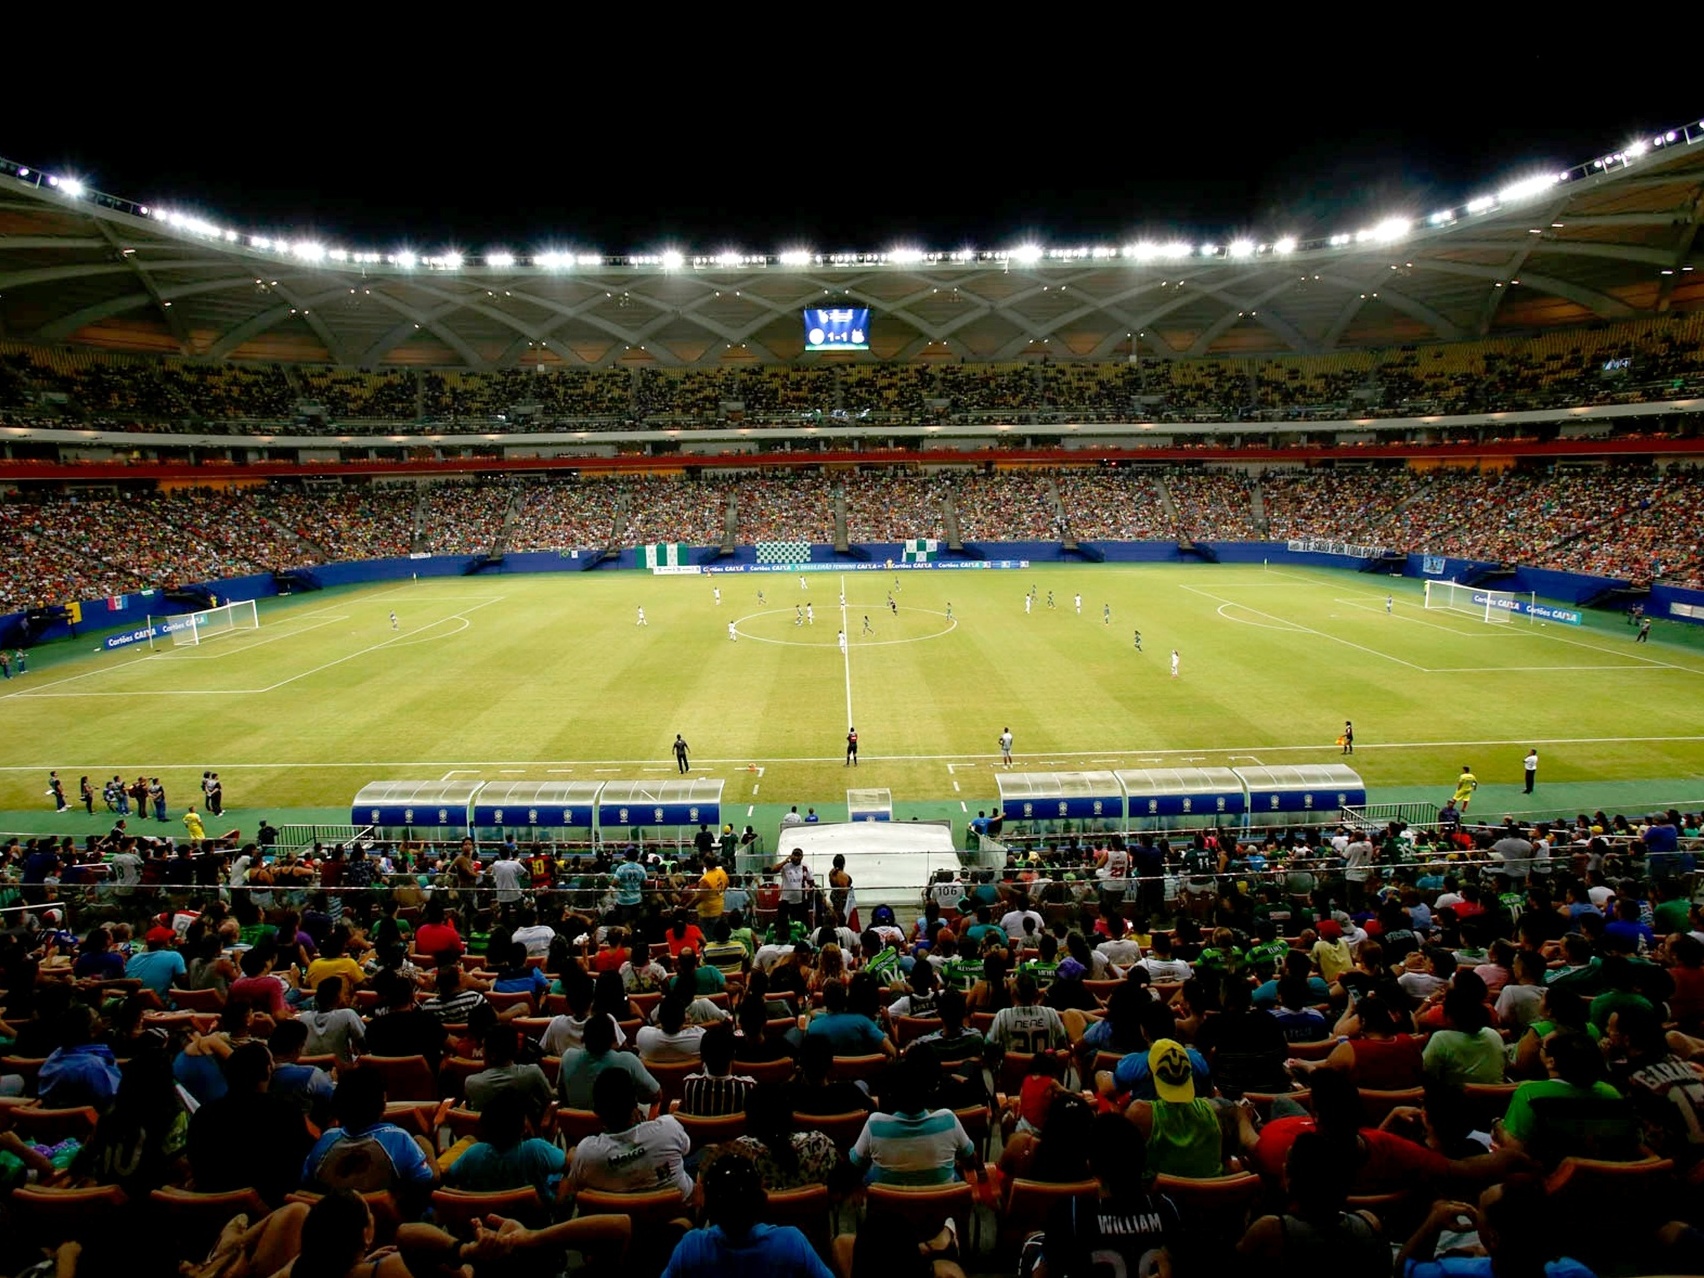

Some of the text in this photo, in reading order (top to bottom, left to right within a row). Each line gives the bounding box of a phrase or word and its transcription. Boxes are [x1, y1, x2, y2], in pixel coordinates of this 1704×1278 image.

[827, 332, 848, 342] 1-1
[1331, 543, 1345, 554] POR
[1497, 599, 1520, 611] CAIXA
[1552, 610, 1577, 622] CAIXA
[108, 634, 133, 647] Cartões
[531, 859, 545, 875] 10
[1097, 1212, 1163, 1236] WILLIAM
